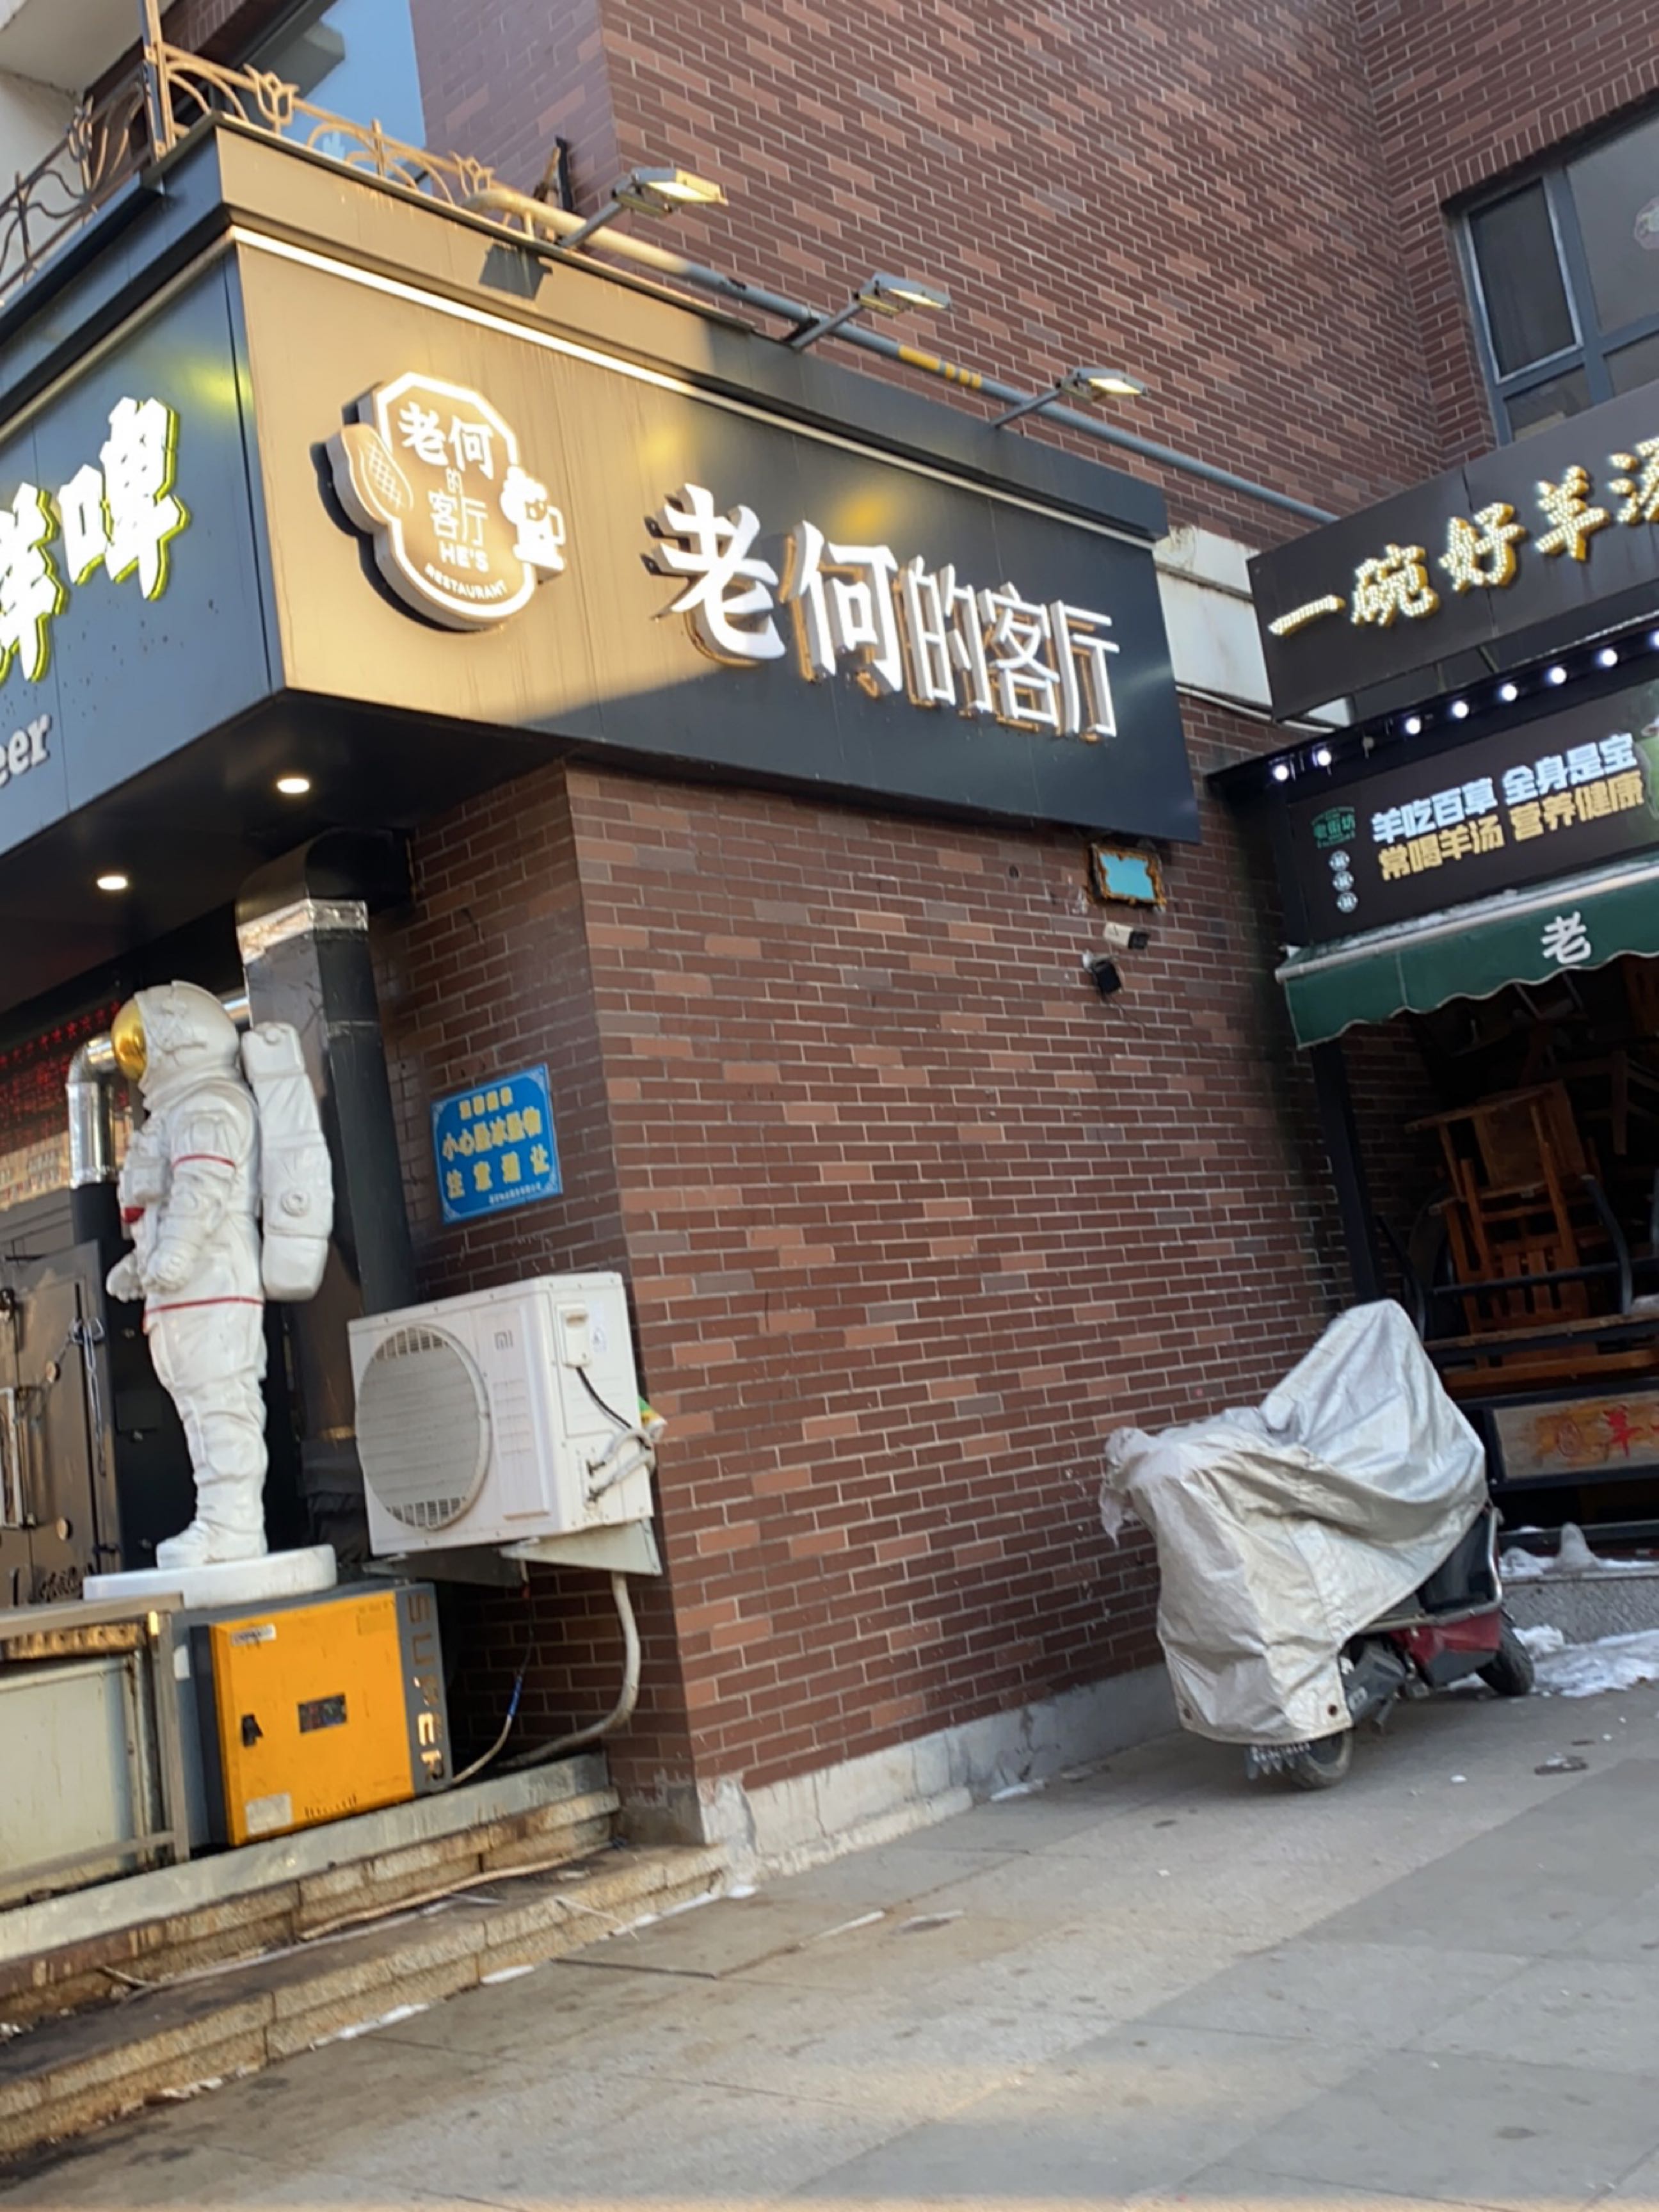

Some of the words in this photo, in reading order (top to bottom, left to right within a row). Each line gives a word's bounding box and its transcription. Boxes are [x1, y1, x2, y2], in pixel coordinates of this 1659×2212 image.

[398, 400, 494, 480] 老何
[428, 488, 488, 547] 客厅
[424, 563, 507, 600] RESTAURANT
[440, 543, 489, 573] HE'S
[649, 483, 1120, 741] 老何的客厅
[1370, 776, 1498, 845] 羊吃百草
[1502, 732, 1639, 806] 全身是宝
[1378, 815, 1505, 881] 常喝羊汤
[1509, 770, 1645, 842] 营养健康
[1540, 911, 1592, 965] 老
